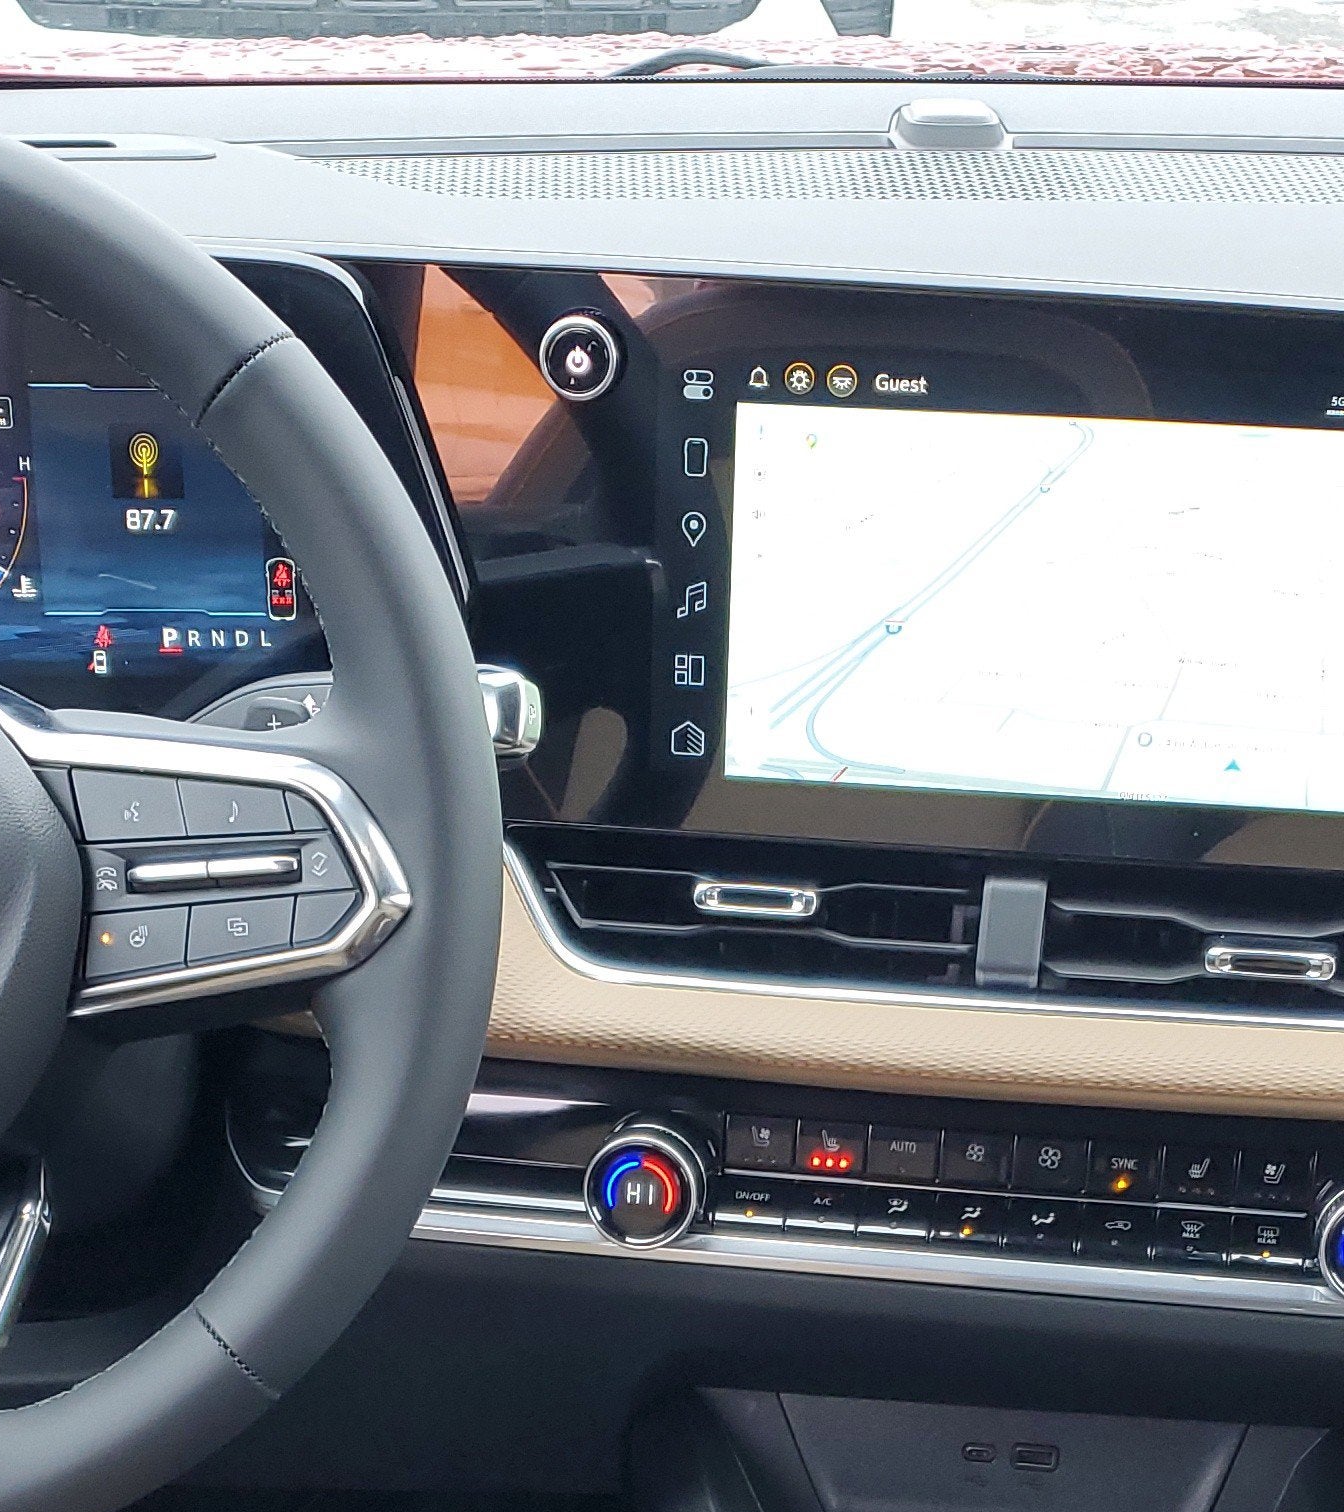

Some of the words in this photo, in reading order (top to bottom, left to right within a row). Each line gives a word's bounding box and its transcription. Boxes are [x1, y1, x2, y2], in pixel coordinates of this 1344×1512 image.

[874, 373, 928, 394] Guest
[19, 457, 30, 471] H
[125, 508, 176, 531] 87.7
[162, 628, 178, 646] P
[188, 630, 201, 646] R
[211, 630, 225, 647] N
[235, 631, 249, 647] D
[260, 631, 272, 647] L
[889, 1140, 917, 1154] AUTO
[1110, 1157, 1139, 1171] SYNC
[626, 1181, 654, 1206] HI
[735, 1190, 771, 1202] ON/OFF
[813, 1197, 832, 1206] A/C
